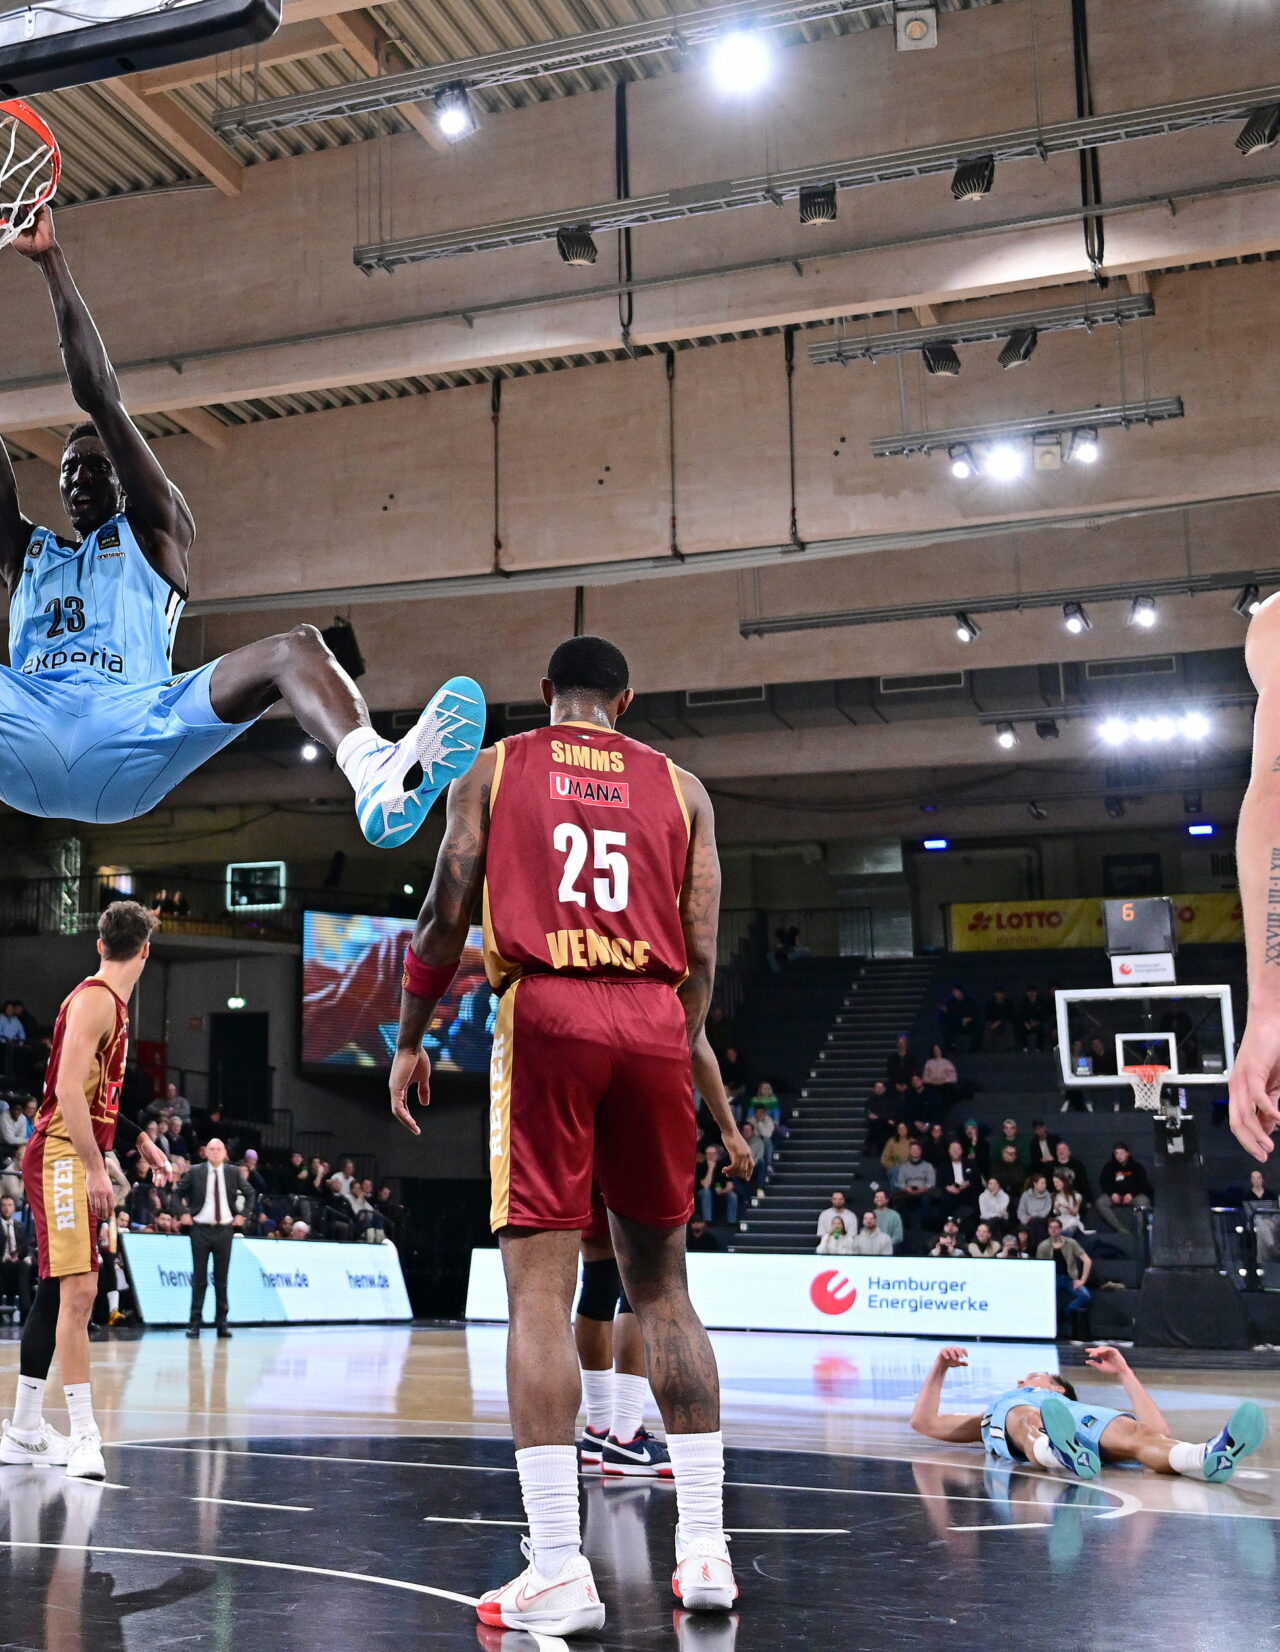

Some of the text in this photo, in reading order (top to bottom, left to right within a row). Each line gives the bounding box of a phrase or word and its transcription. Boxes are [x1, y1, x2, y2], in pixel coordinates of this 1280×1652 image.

[44, 595, 86, 639] 23
[23, 647, 124, 674] experia
[550, 740, 625, 773] SIMMS
[555, 776, 623, 803] UMANA
[553, 822, 629, 912] 25
[996, 911, 1063, 930] LOTTO
[1122, 903, 1136, 922] 6
[53, 1158, 76, 1231] REYER
[259, 1268, 310, 1289] henw.de
[346, 1269, 390, 1289] henw.de
[868, 1276, 967, 1294] Hamburger
[868, 1294, 988, 1312] Energiewerke
